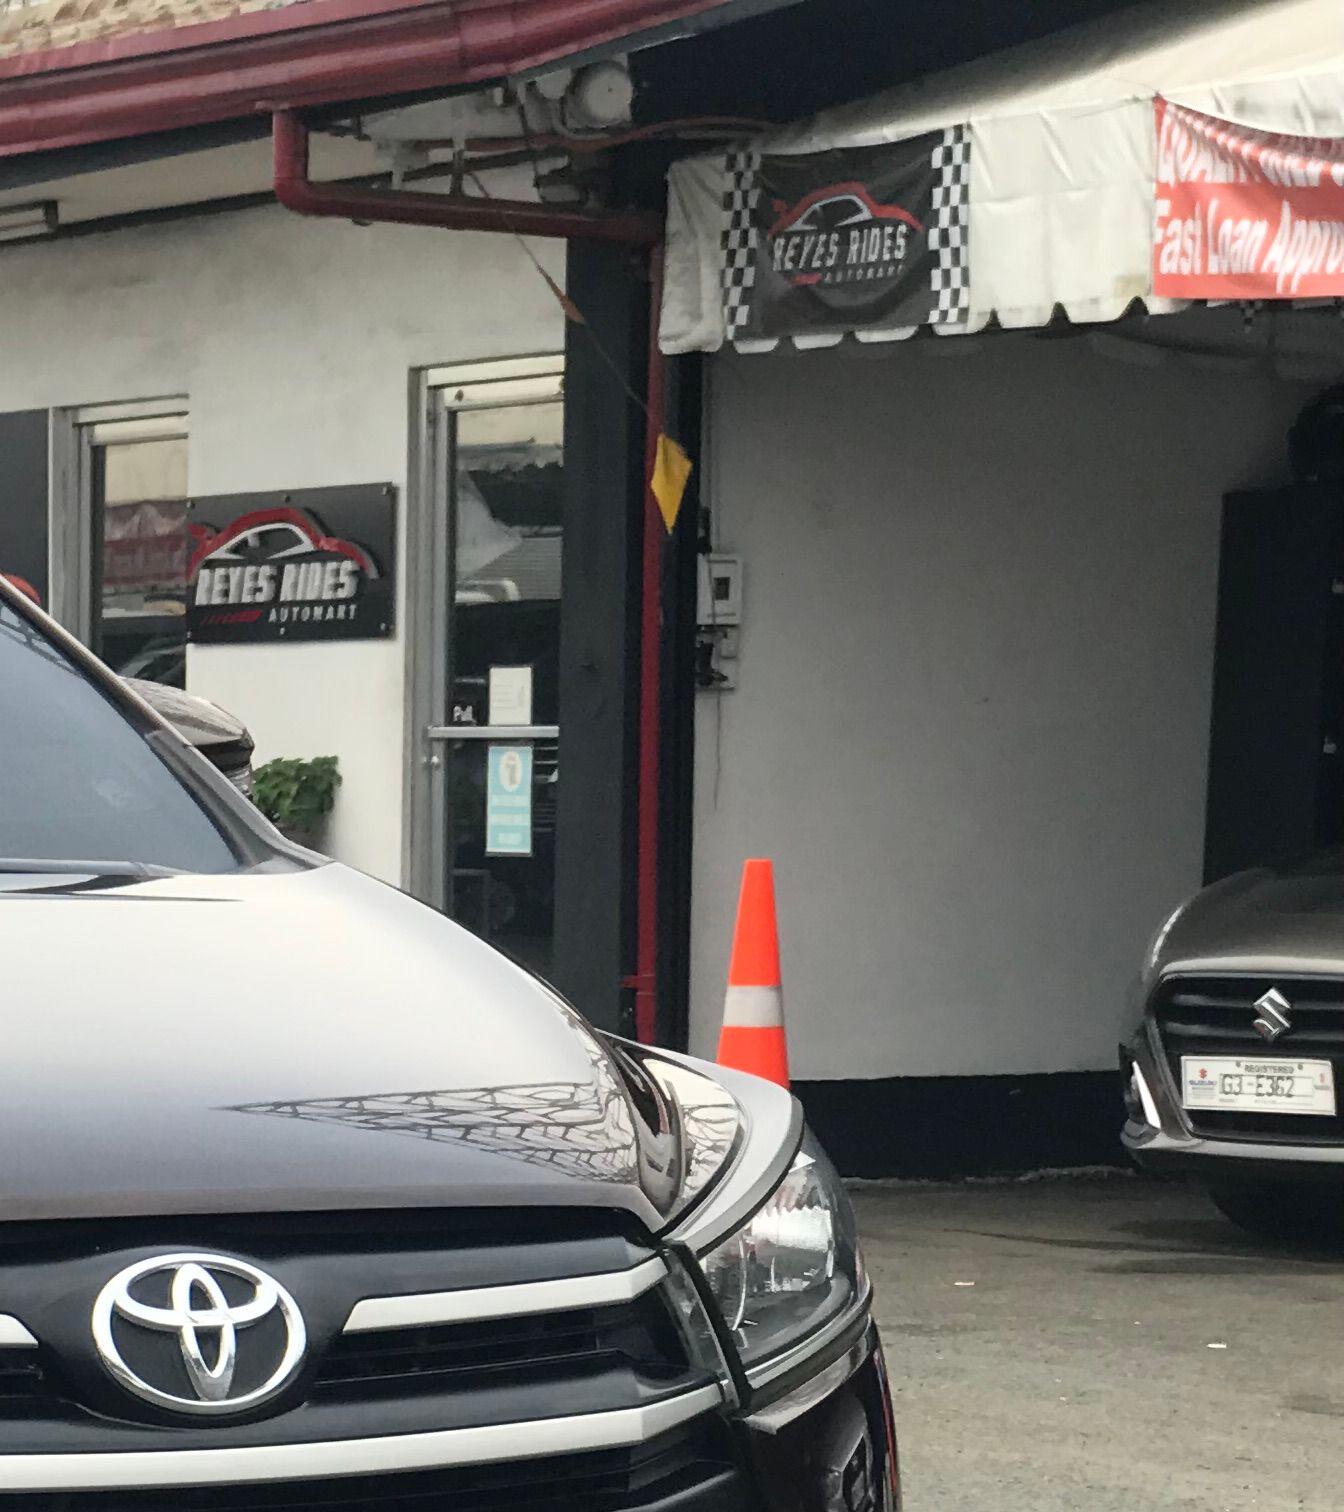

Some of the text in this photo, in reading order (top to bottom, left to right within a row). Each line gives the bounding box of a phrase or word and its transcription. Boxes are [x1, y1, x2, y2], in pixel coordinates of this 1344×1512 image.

[772, 224, 908, 272] REYES RIDES
[1154, 199, 1203, 276] Fast
[1207, 199, 1269, 276] Loan
[195, 559, 360, 607] REYES RIDES
[267, 603, 358, 623] AUTOMART
